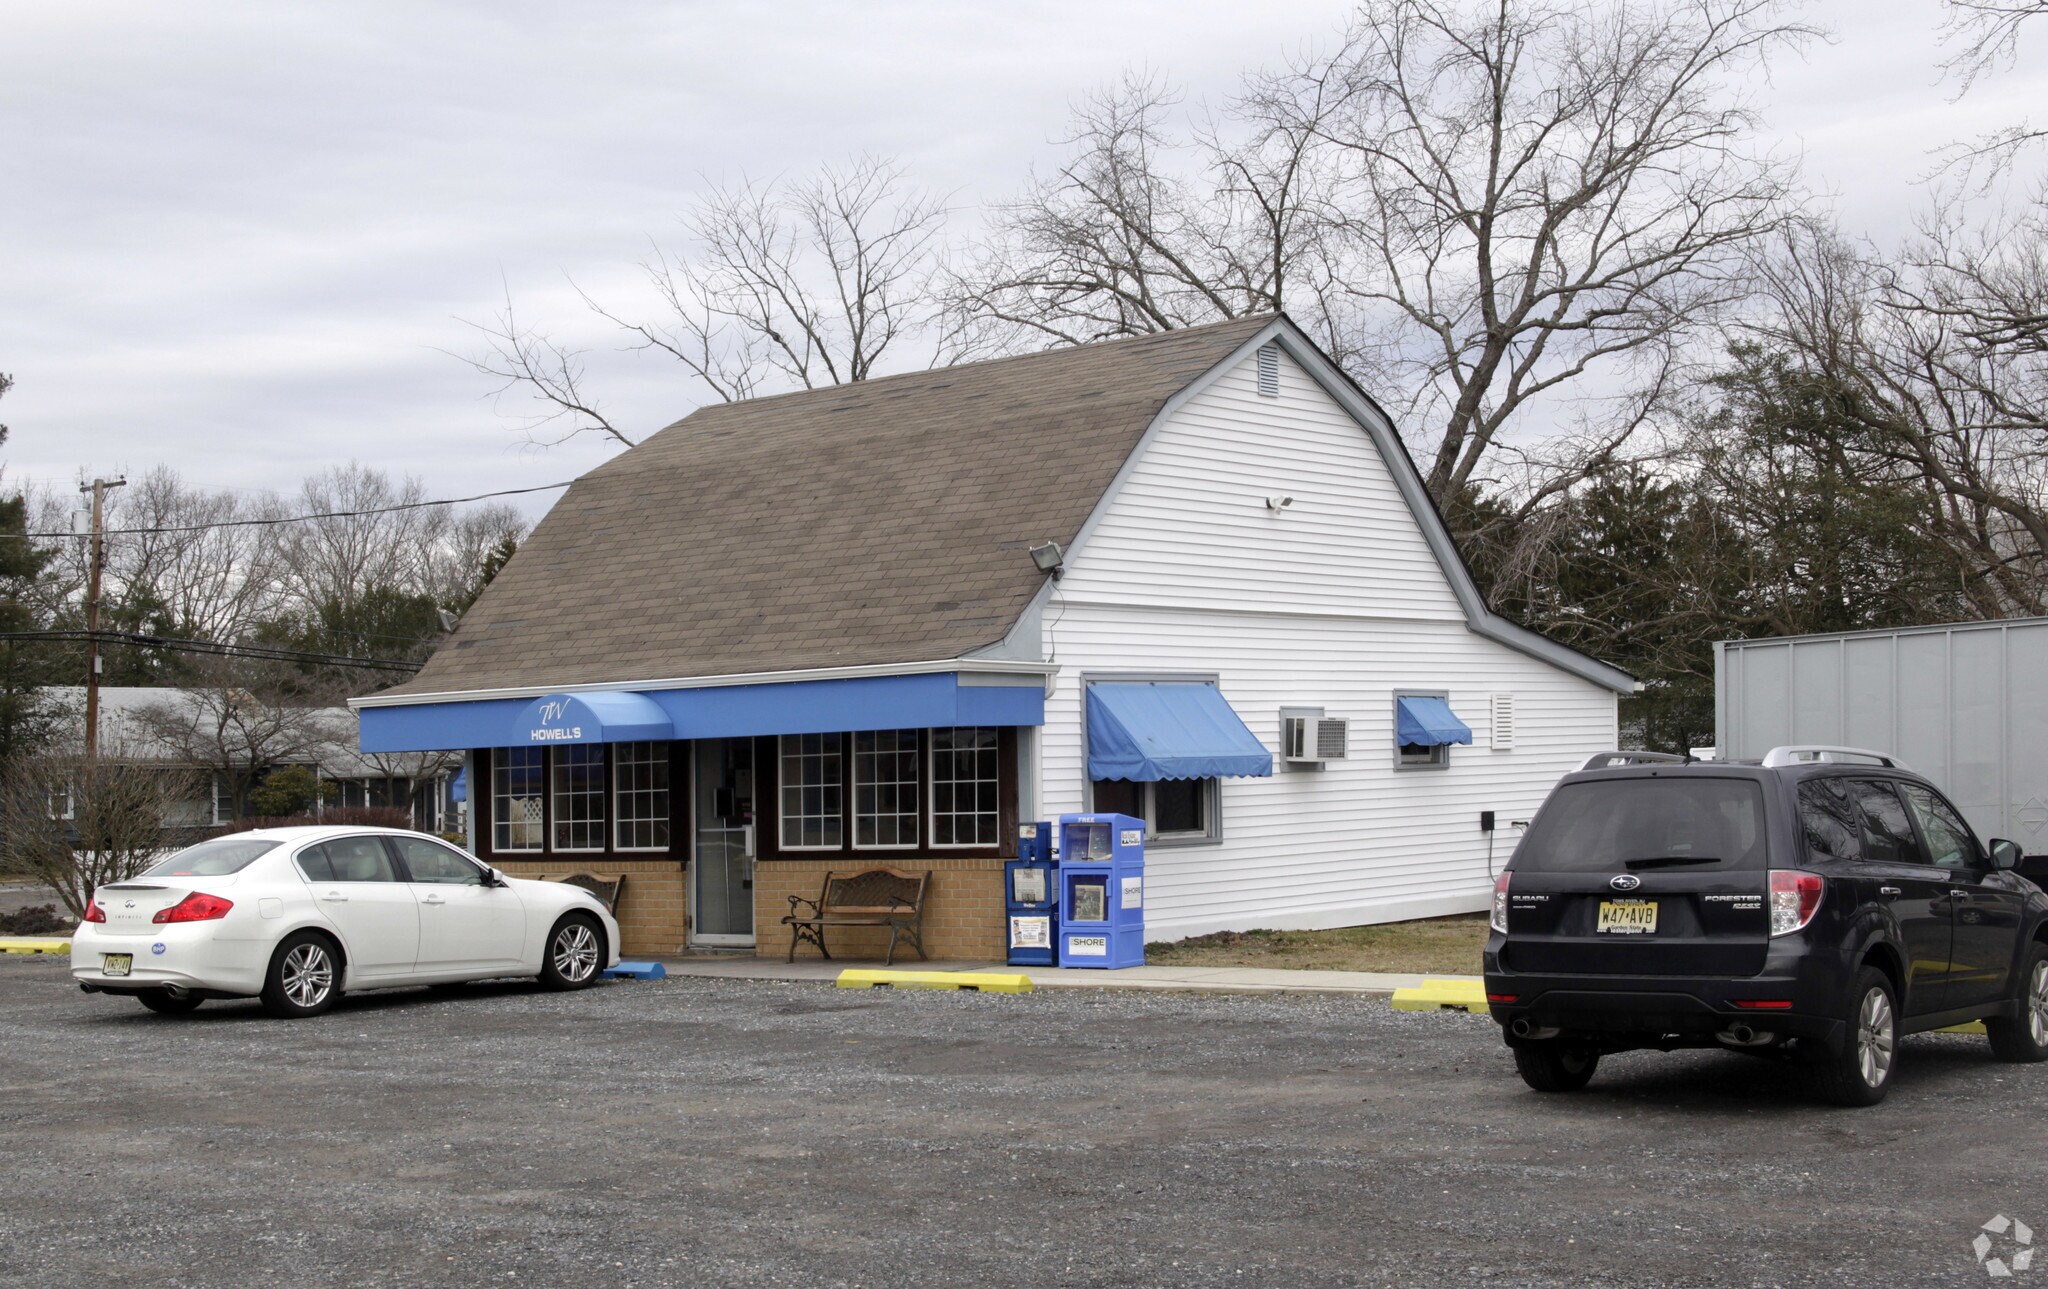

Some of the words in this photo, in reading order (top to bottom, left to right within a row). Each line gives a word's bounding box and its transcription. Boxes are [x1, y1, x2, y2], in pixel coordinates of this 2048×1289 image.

[531, 727, 581, 741] HOWELL'S
[1124, 887, 1141, 895] SHORE
[1073, 938, 1105, 947] SHORE
